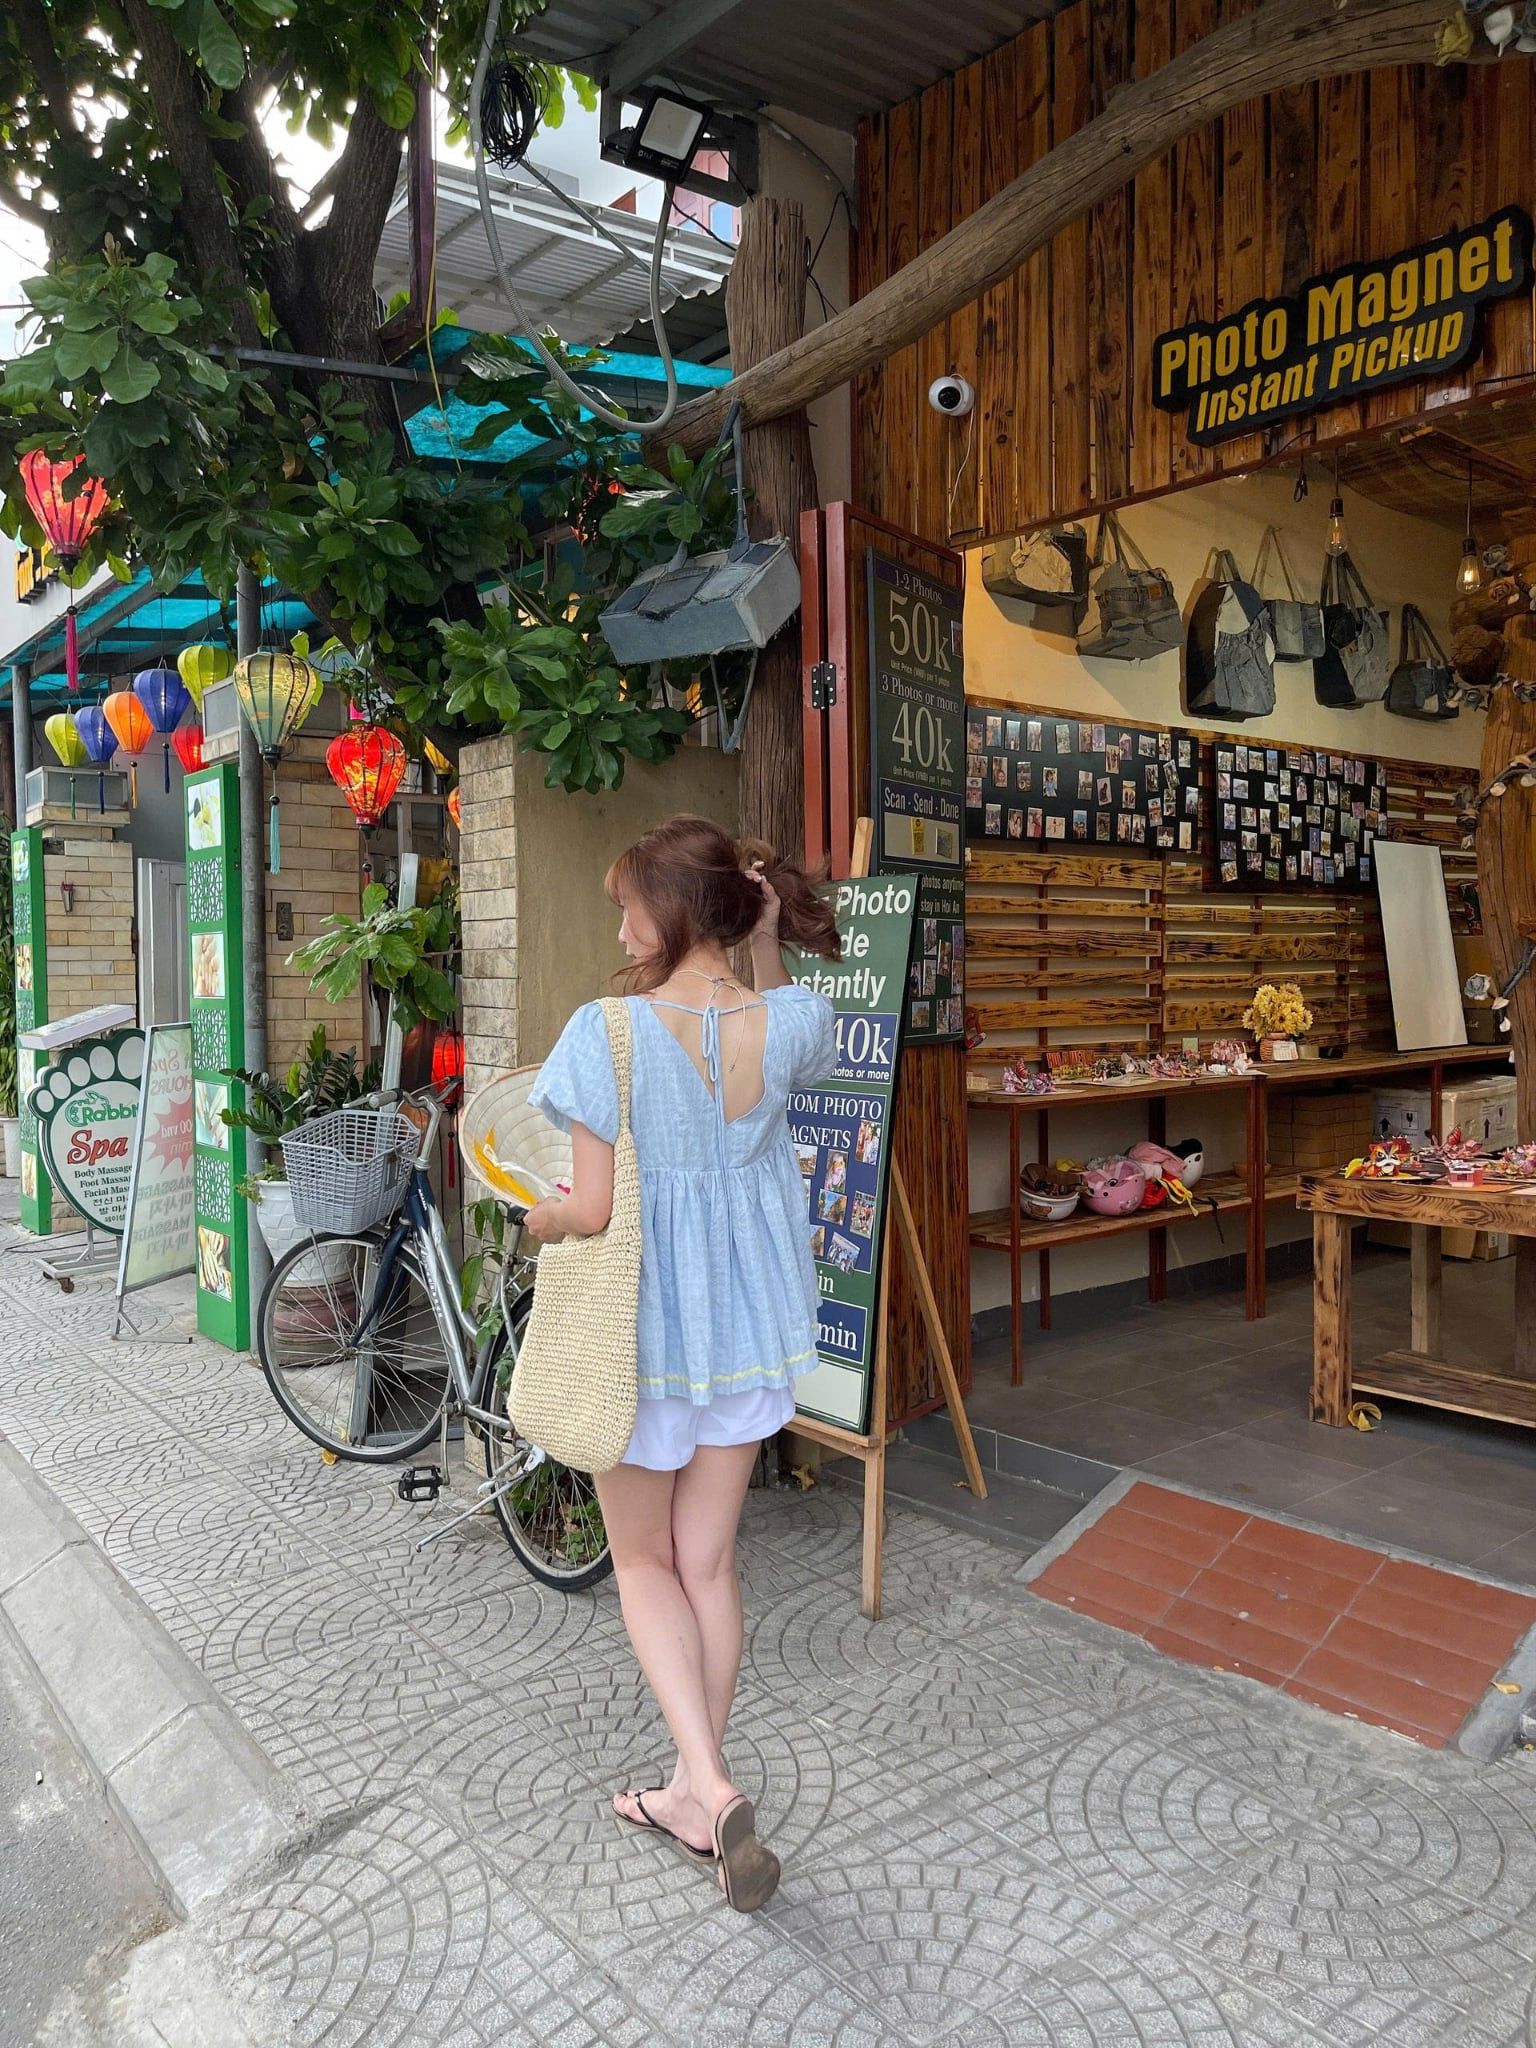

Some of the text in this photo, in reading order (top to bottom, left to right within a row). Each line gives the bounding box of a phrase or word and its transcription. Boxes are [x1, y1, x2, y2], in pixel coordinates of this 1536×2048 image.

[1160, 216, 1513, 397] Photo Magnet
[1195, 310, 1464, 433] Instant Pickup
[896, 570, 942, 604] 1-2 Photos
[889, 590, 952, 673] 50k
[882, 674, 958, 714] 3 Photos or more
[892, 702, 954, 773] 40k
[884, 787, 960, 820] Scan Send Done
[834, 884, 911, 916] Photo
[920, 898, 934, 916] stay
[856, 1069, 865, 1078] or
[867, 1070, 890, 1080] more
[82, 1103, 138, 1125] Rabbi
[786, 1093, 882, 1120] TOM PHOTO
[67, 1130, 128, 1166] Spa
[788, 1124, 851, 1148] AGNETS
[74, 1168, 96, 1178] Body
[80, 1176, 130, 1188] Foot Massa
[84, 1188, 108, 1198] Facial
